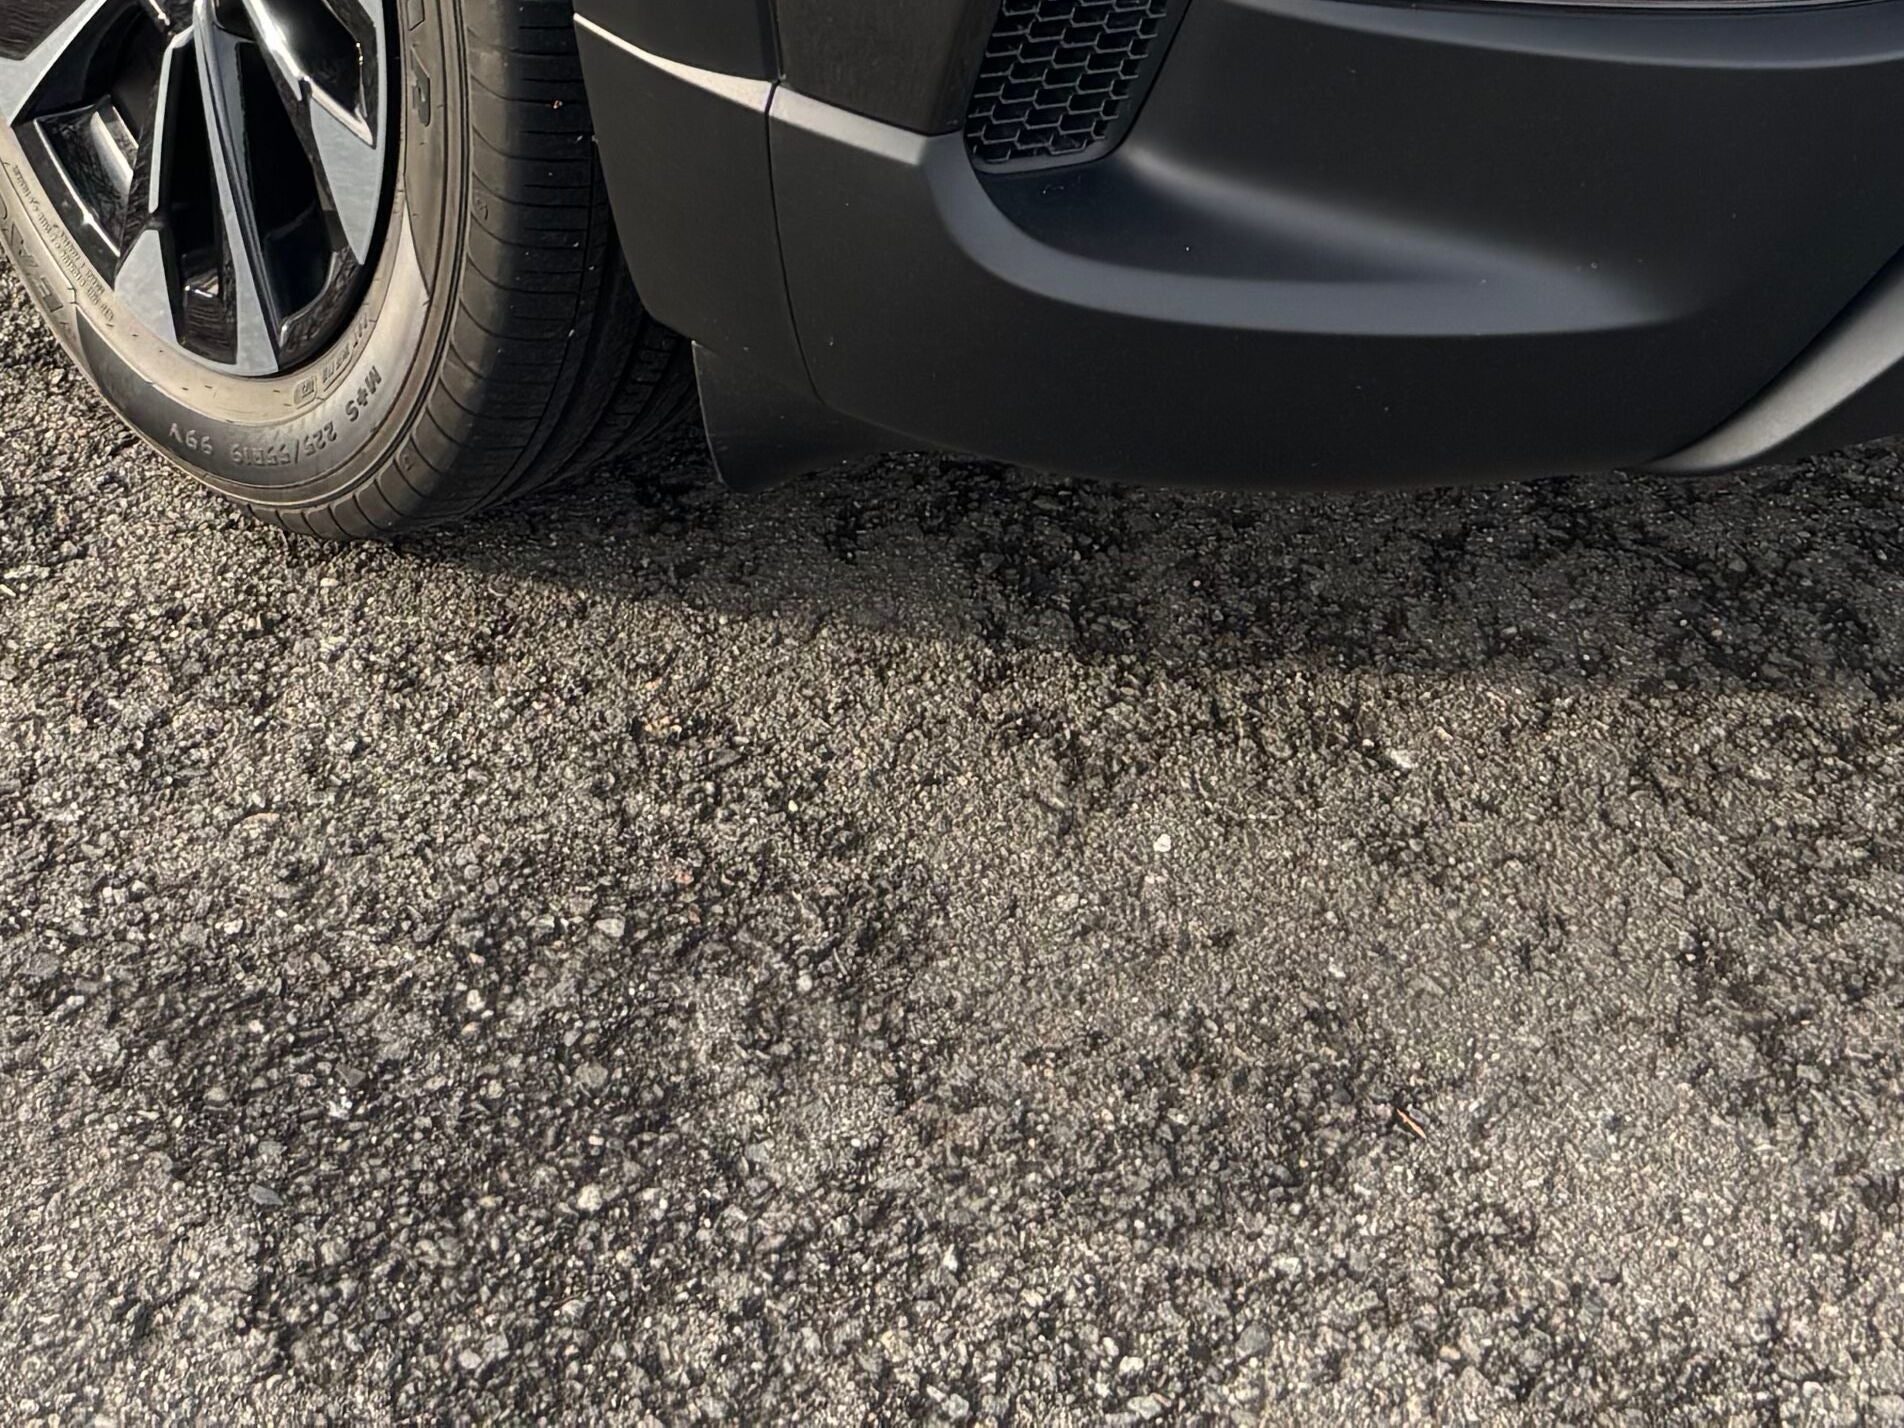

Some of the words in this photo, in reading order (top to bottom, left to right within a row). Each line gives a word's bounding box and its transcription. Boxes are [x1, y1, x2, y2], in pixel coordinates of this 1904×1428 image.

[346, 365, 383, 422] M+S
[168, 422, 214, 456] 99V
[232, 421, 338, 467] 225/55R19
